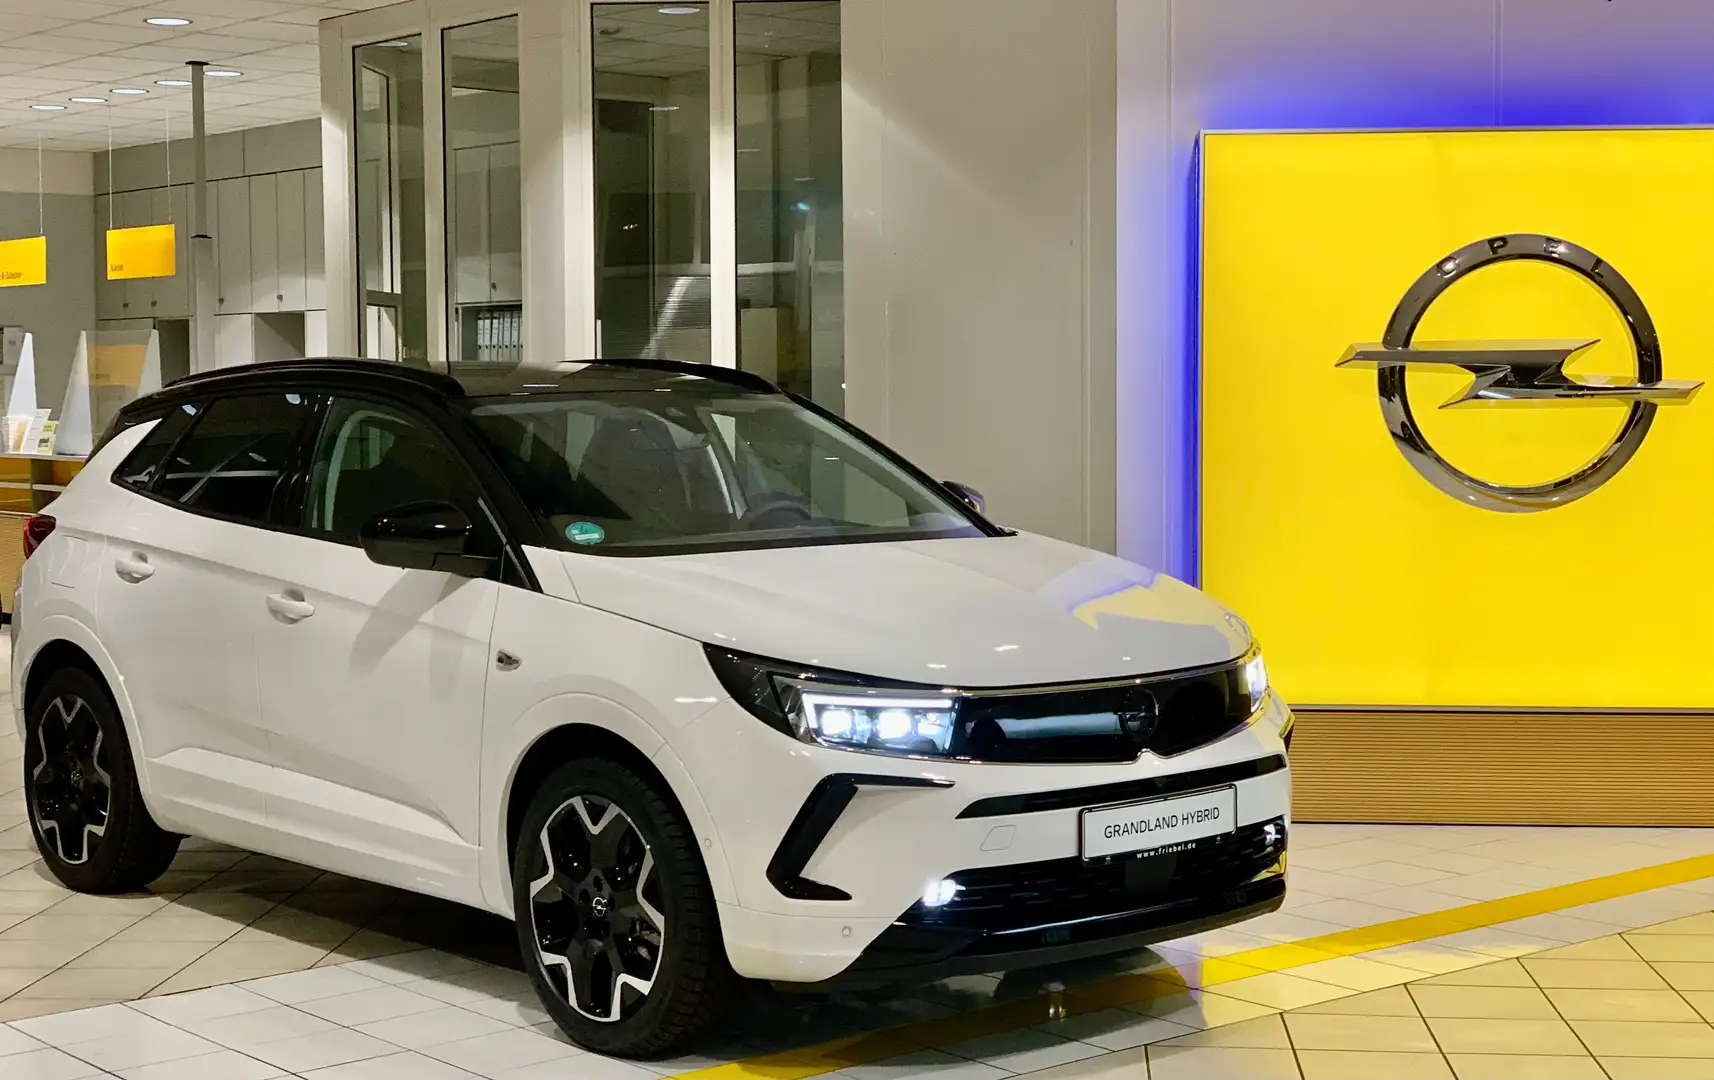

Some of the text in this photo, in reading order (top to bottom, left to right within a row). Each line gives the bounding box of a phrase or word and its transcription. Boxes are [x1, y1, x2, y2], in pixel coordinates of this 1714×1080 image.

[1436, 236, 1604, 279] OPEL
[1104, 807, 1220, 839] GRANDLAND HYBRID
[1136, 842, 1196, 859] www.friebel.de
